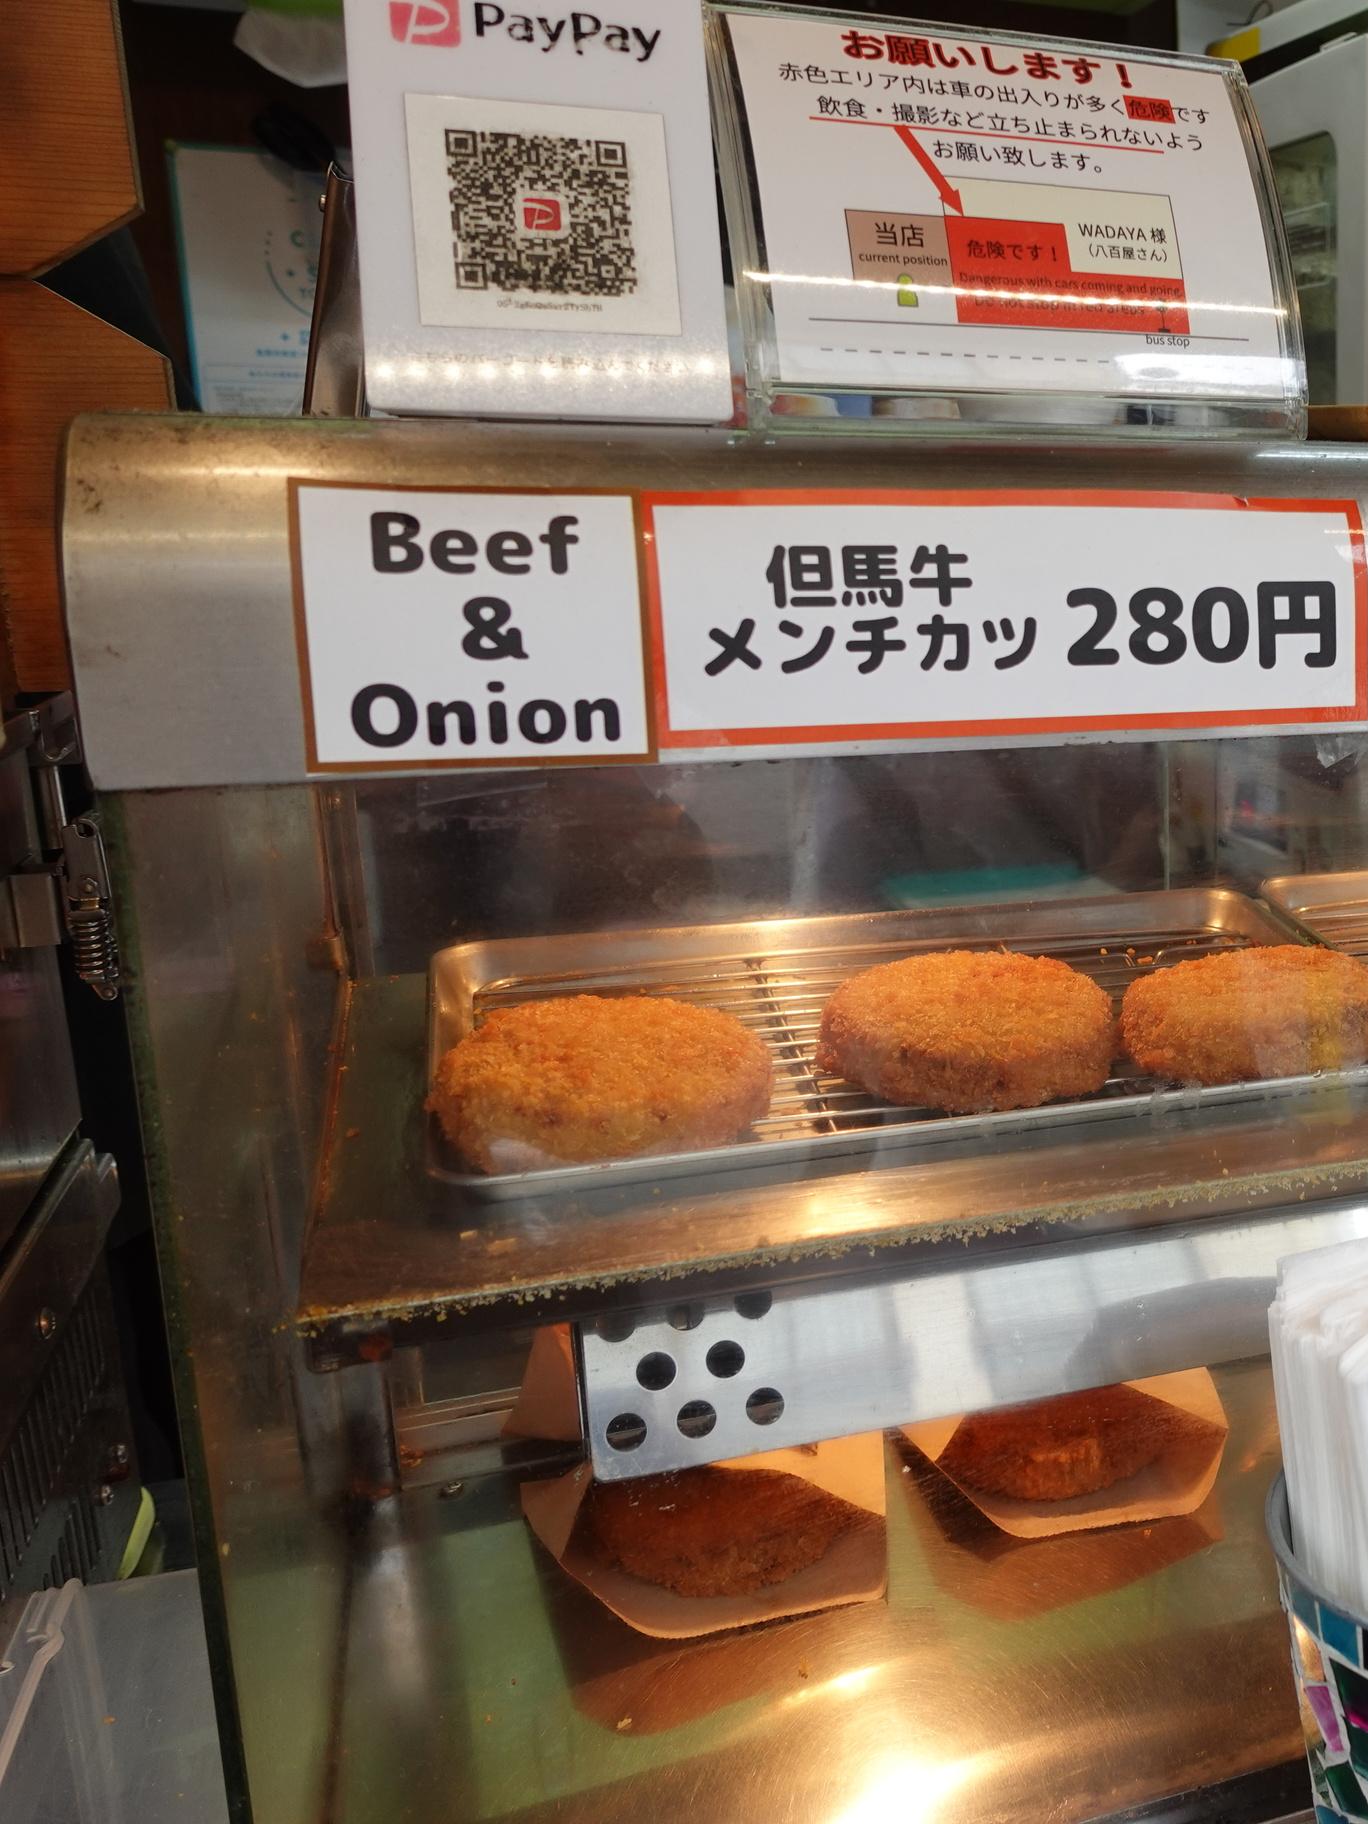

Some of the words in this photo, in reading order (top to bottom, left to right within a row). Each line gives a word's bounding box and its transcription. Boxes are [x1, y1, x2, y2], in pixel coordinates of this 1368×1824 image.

[473, 1, 661, 62] PayPay
[840, 30, 1132, 88] お願いします！
[779, 62, 1209, 124] 赤色エリア内は車の出入りが多く危険です
[817, 96, 1202, 150] 飲食・撮影など立ち止まられないよう
[933, 139, 1102, 173] お願い致します。
[859, 253, 900, 264] current
[903, 255, 948, 266] position
[874, 221, 924, 248] 当店
[1078, 223, 1147, 242] WADAYA
[1150, 228, 1167, 245] 様
[959, 272, 1026, 287] Dangerous
[1027, 276, 1053, 288] with
[1055, 280, 1079, 290] cars
[1080, 280, 1124, 294] coming
[1126, 281, 1147, 293] and
[1145, 334, 1164, 345] bus
[1168, 335, 1190, 348] stop
[370, 511, 579, 575] Beef
[766, 544, 972, 608] 但馬牛
[461, 596, 530, 660] &
[704, 614, 1037, 676] メンチカツ
[1066, 581, 1336, 669] 280円
[350, 681, 621, 748] Onion
